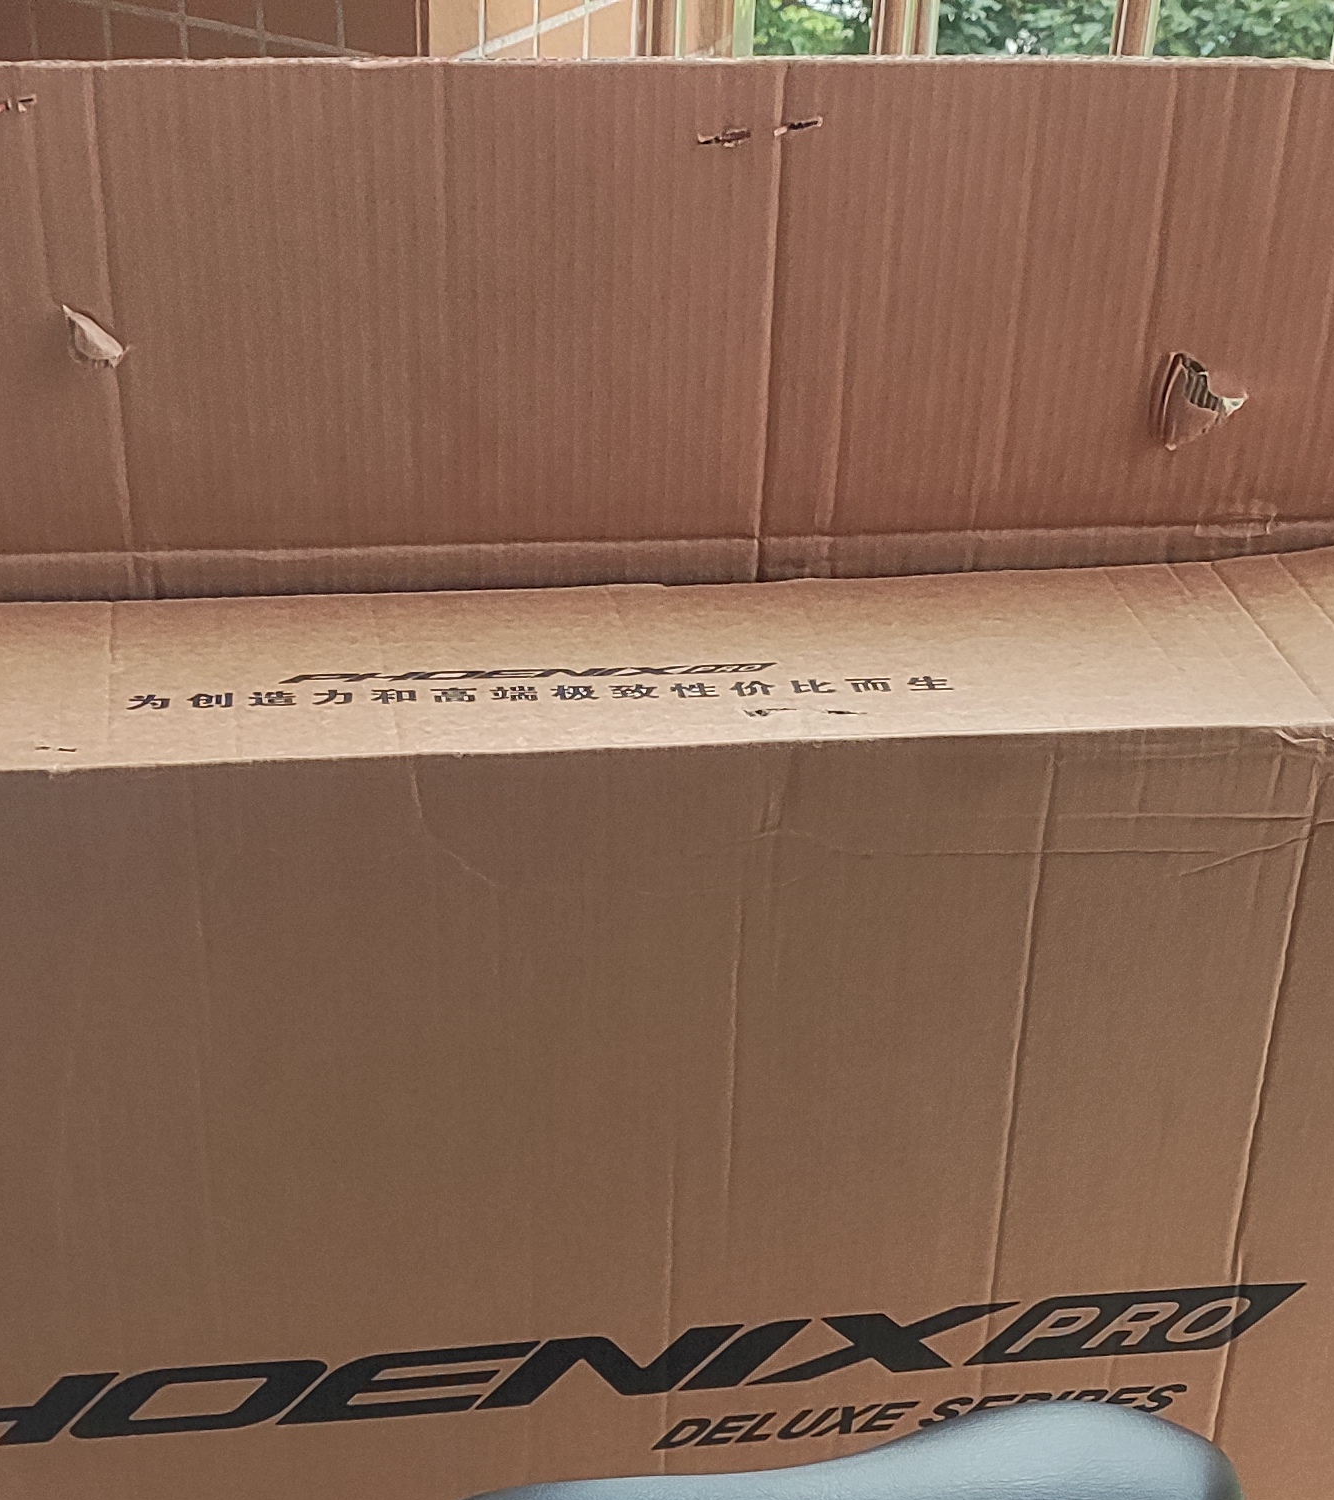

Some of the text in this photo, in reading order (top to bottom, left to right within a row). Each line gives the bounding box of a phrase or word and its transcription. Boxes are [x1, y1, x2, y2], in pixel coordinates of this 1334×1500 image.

[127, 676, 955, 712] 为创造力和高端极致性价比而生
[279, 663, 689, 685] PHOENIX
[997, 1294, 1259, 1357] PRO
[651, 1400, 924, 1451] DELUXE
